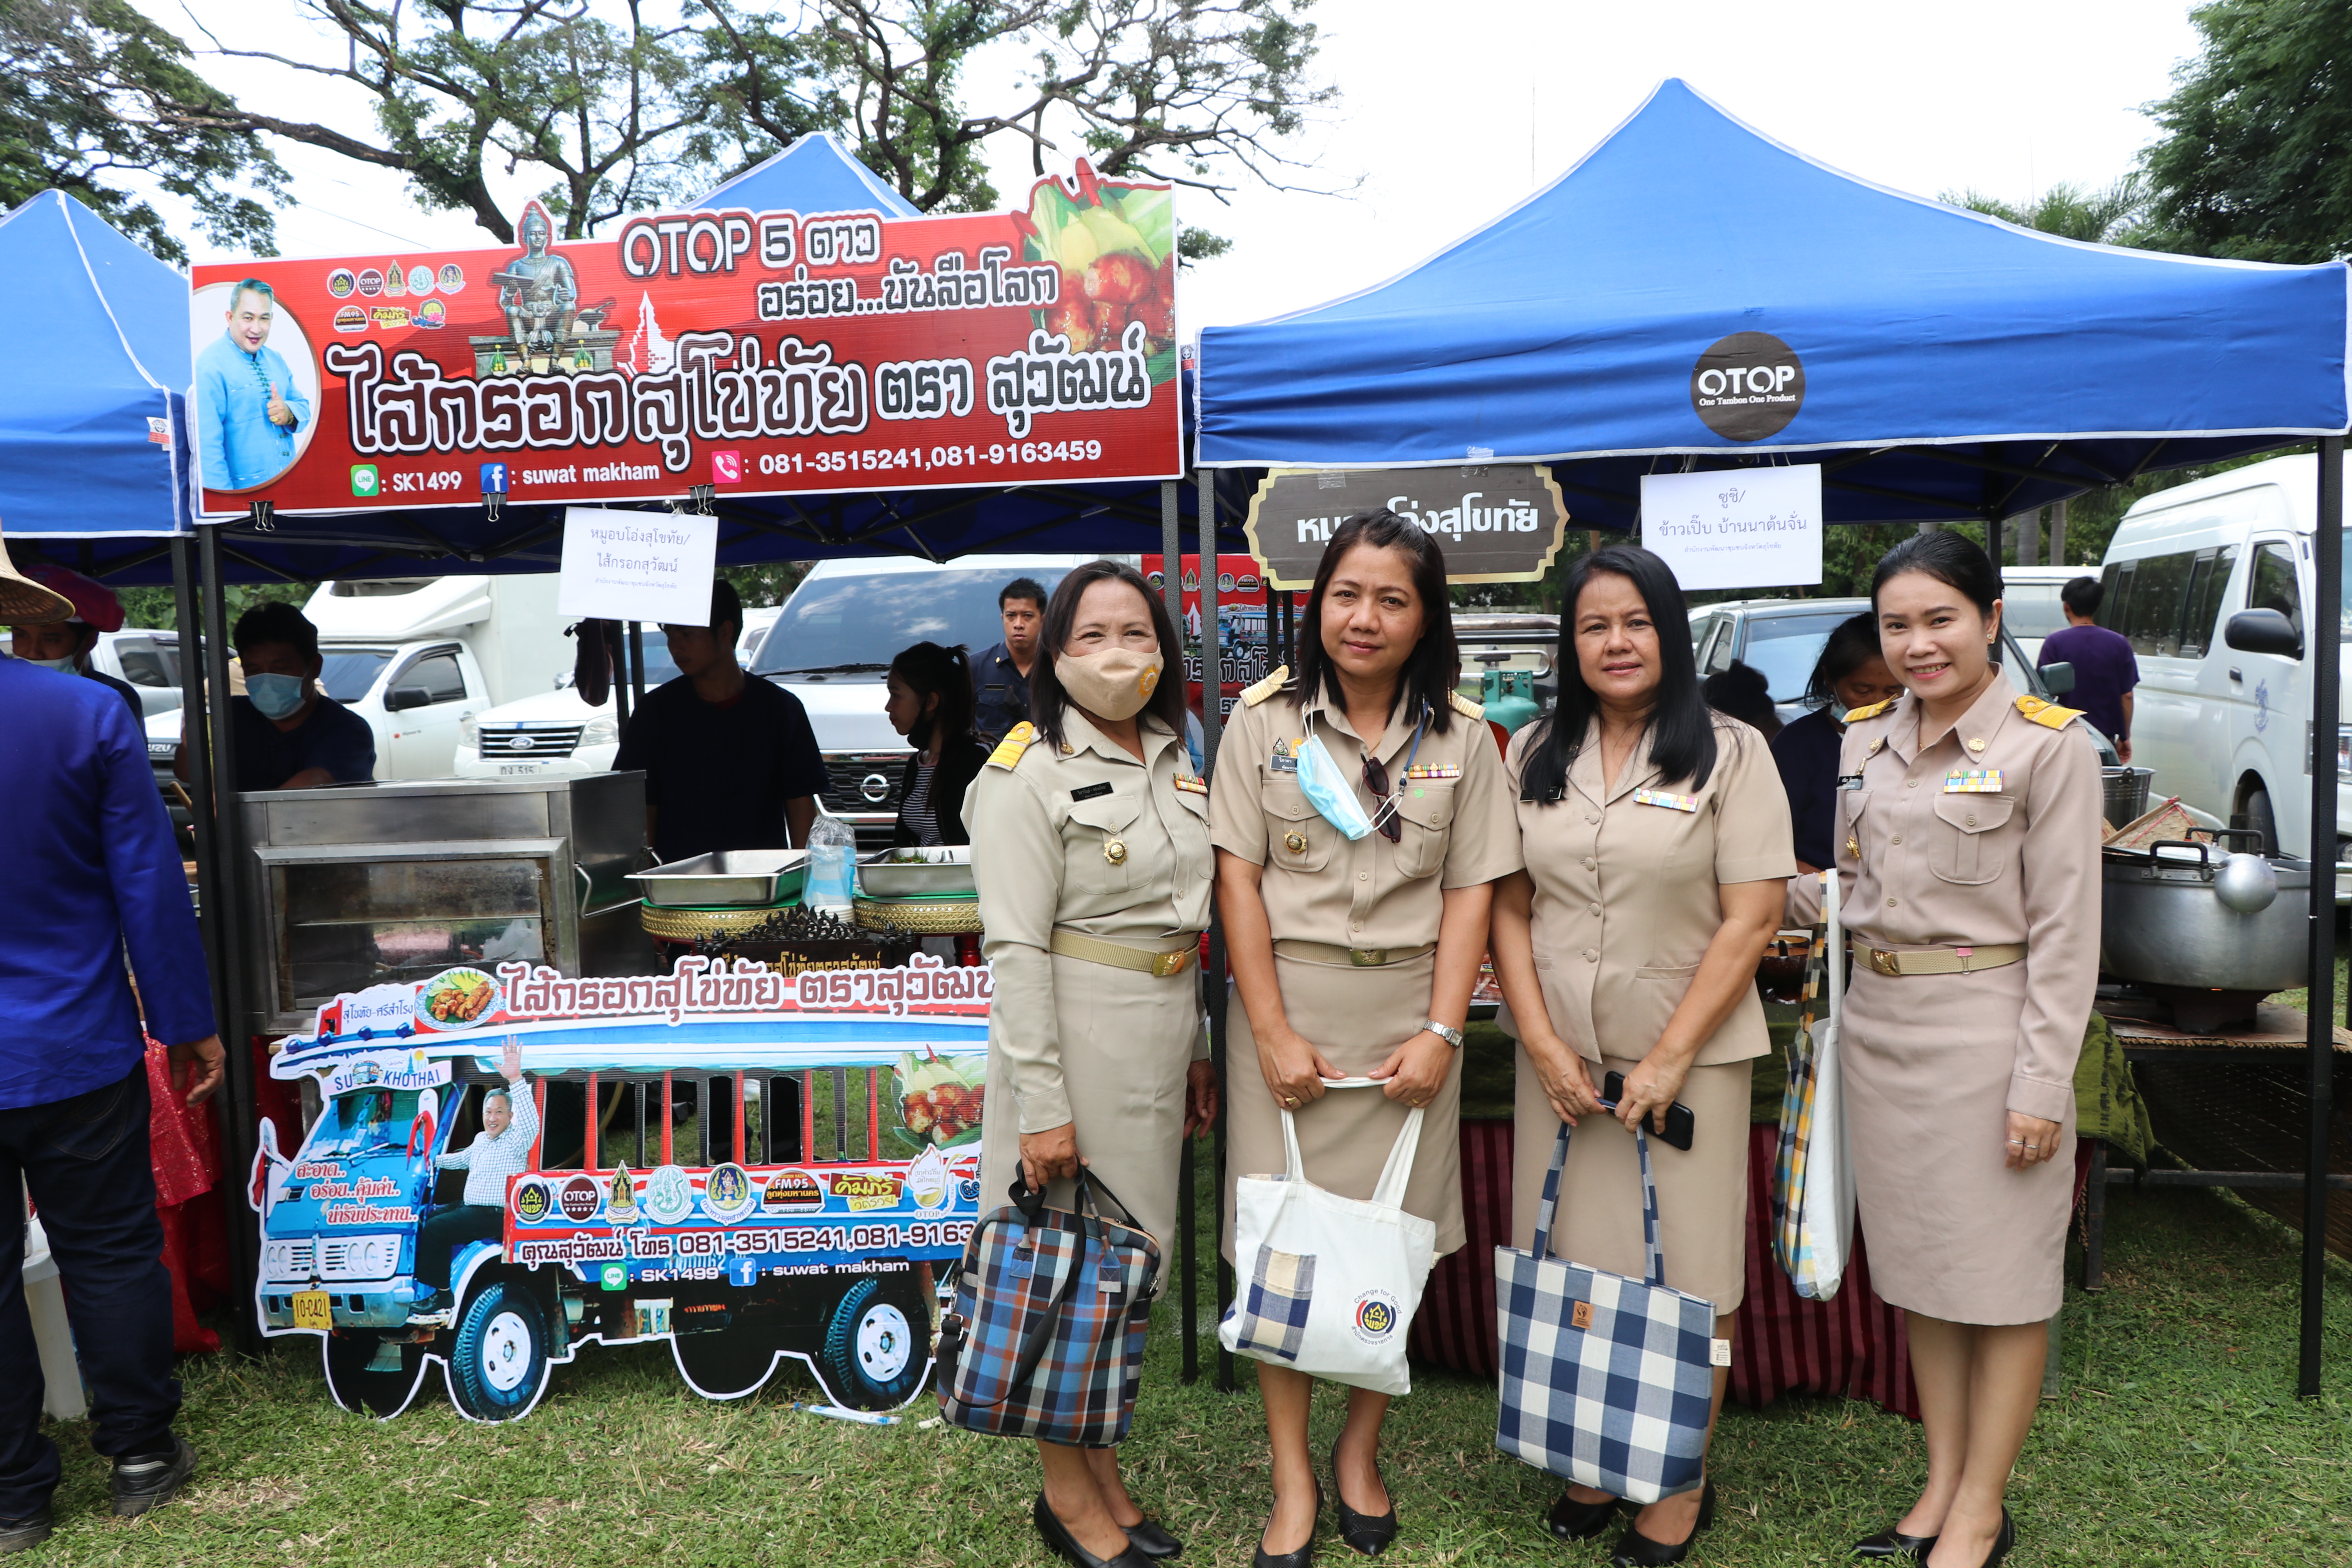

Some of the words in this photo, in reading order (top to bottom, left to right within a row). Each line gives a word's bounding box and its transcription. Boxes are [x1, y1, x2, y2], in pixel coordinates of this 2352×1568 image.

[623, 220, 752, 276] OTOP
[763, 221, 793, 264] 5
[808, 223, 878, 263] ดาว
[878, 361, 971, 416] ตรา
[990, 325, 1148, 435] สุวัฒน์
[1698, 365, 1795, 396] OTOP
[1699, 398, 1716, 406] One
[1717, 396, 1748, 405] Tambon
[1748, 394, 1765, 403] One
[1766, 394, 1796, 403] Product
[759, 440, 1102, 474] 081-3515241,081-9163459
[392, 471, 462, 492] SK1499
[523, 464, 576, 485] suwat
[583, 462, 660, 482] makham
[1719, 488, 1746, 508] ซูชิ/
[1718, 511, 1807, 534] บ้านนาต้นจั่น
[590, 526, 690, 547] หมูอบโอ่งสุโขทัย/
[597, 552, 678, 575] ไส้กรอกสุวัฒน์
[518, 766, 534, 774] 515
[799, 955, 996, 1018] ตราสุวัฒน
[343, 999, 413, 1024] สุโขทัย-ศรีสำโรง
[334, 1073, 353, 1090] SU
[383, 1069, 440, 1087] KHOTHAI
[296, 1163, 346, 1179] สะอาด..
[775, 1178, 792, 1189] FM
[793, 1178, 809, 1189] 95
[835, 1174, 894, 1195] คัมภีร์
[564, 1190, 596, 1201] OTOP
[766, 1189, 819, 1200] ลูกทุ่งมหานคร
[327, 1205, 418, 1224] น่ารับประทาน..
[522, 1230, 624, 1269] คุณสุวัฒน์
[630, 1230, 670, 1255] โทร
[641, 1267, 719, 1281] SK1499
[773, 1264, 828, 1276] suwat
[835, 1260, 909, 1274] makham
[1354, 1289, 1378, 1304] Change
[1381, 1289, 1390, 1297] for
[1390, 1296, 1402, 1314] Good
